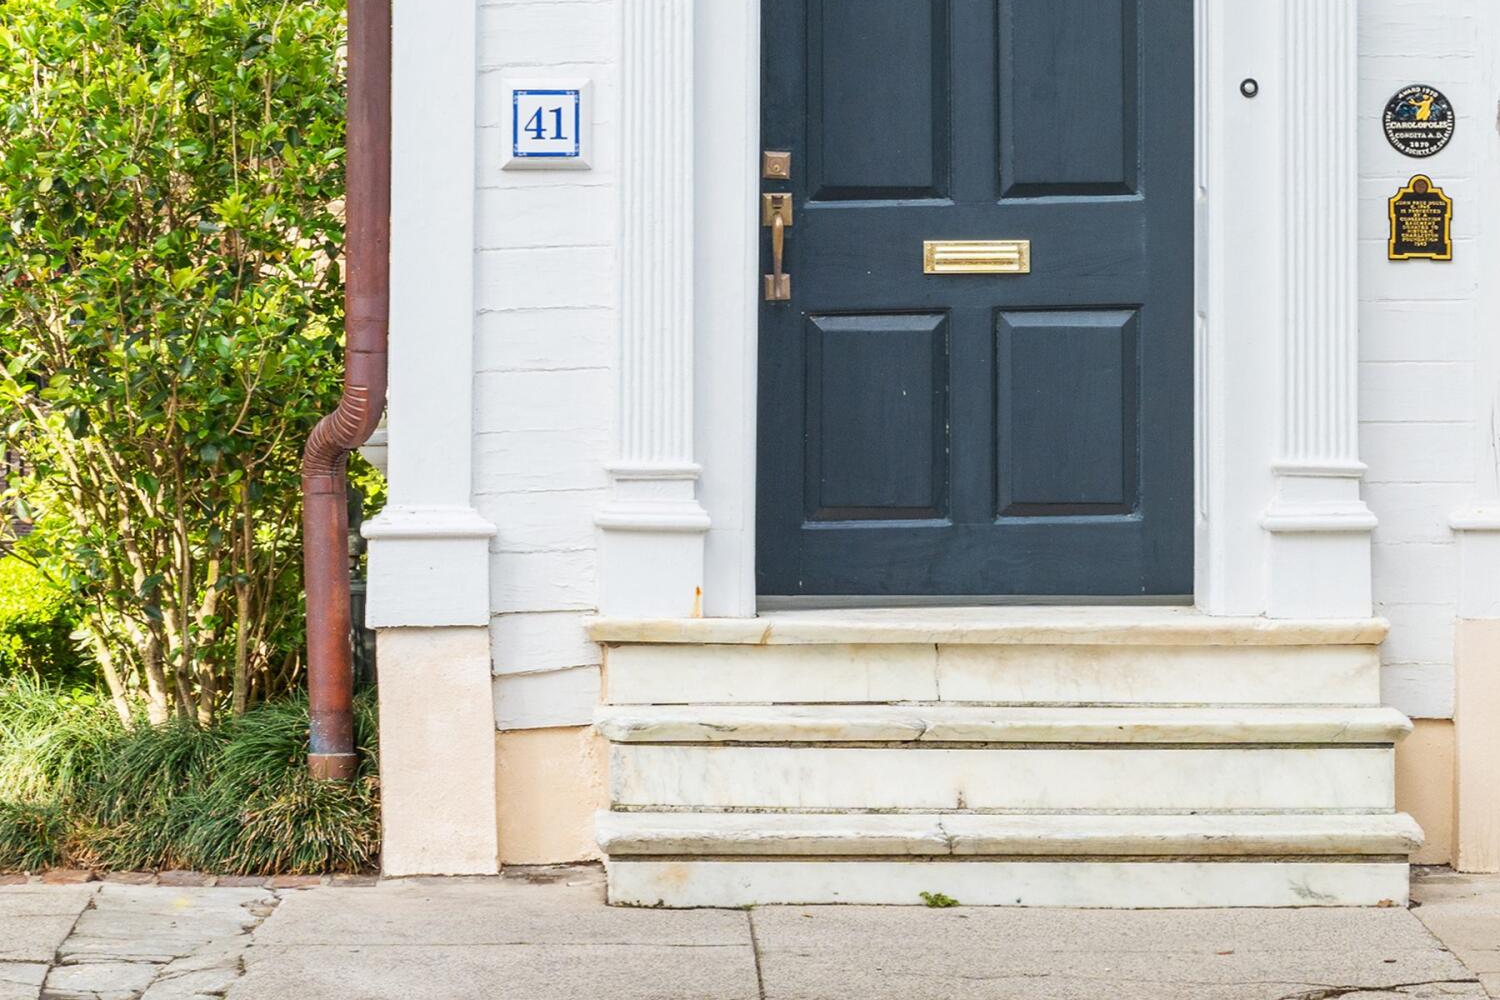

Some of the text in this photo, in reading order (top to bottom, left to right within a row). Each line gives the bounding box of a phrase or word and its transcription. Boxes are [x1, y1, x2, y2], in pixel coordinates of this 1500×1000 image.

[1398, 87, 1421, 98] AWARD
[524, 106, 568, 140] 41
[1390, 121, 1448, 129] CAROLOPOLIS
